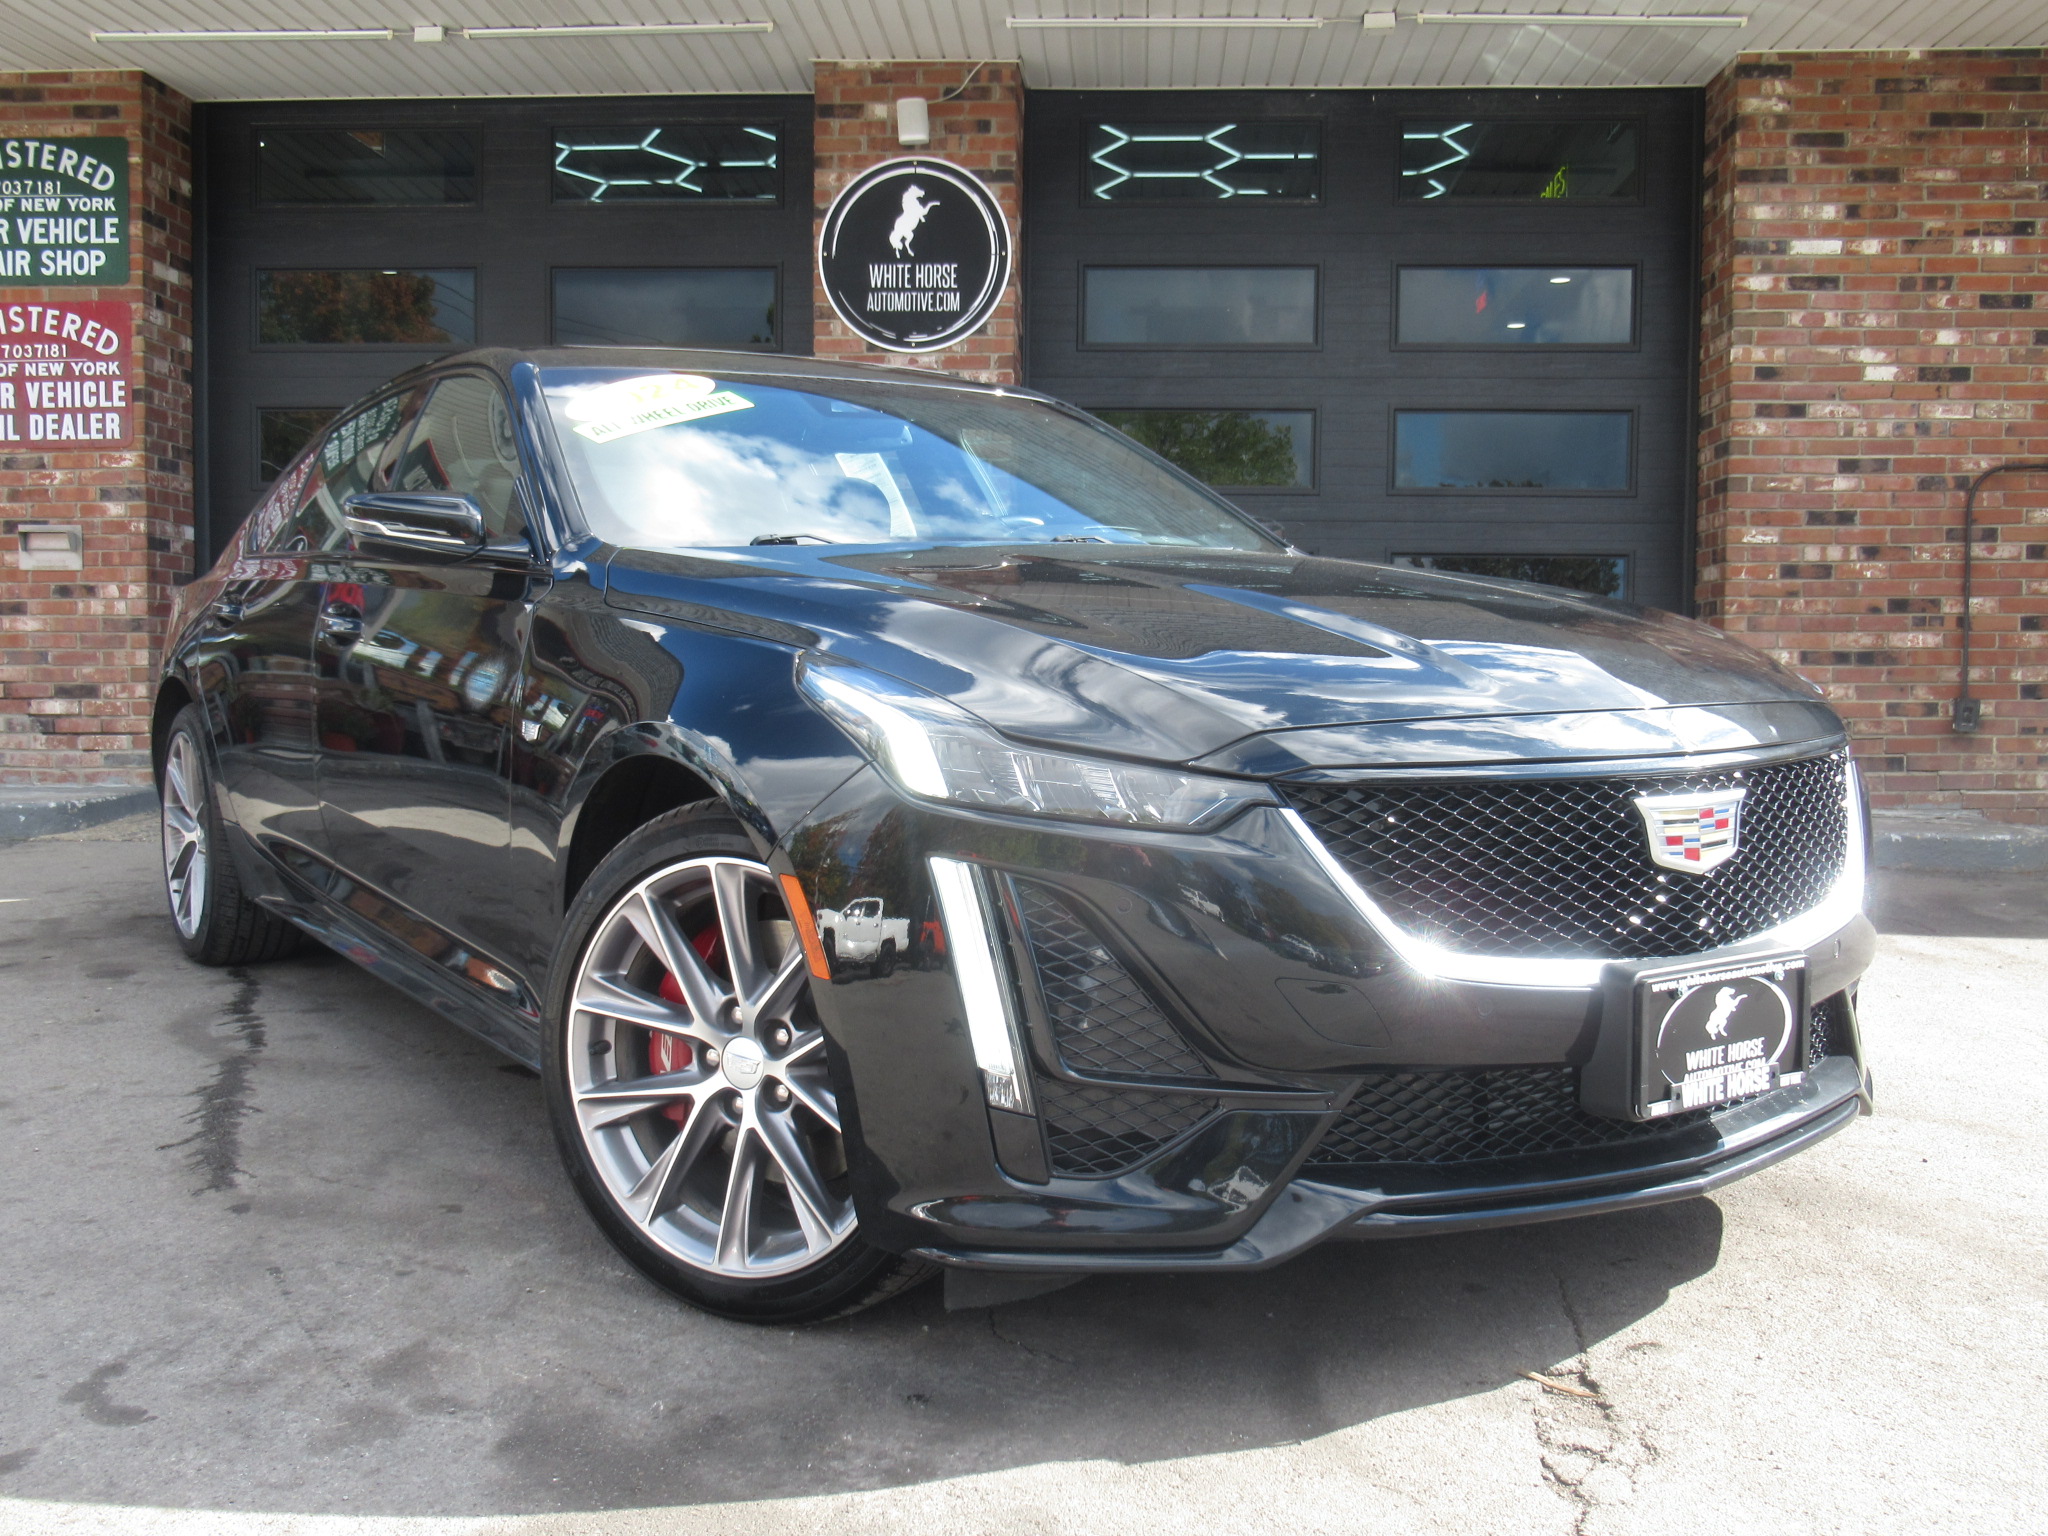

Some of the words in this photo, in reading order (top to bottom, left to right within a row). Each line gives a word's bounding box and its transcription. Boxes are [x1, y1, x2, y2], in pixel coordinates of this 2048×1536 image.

[0, 180, 61, 195] 037181
[21, 198, 60, 212] NEW
[67, 197, 116, 212] YORK
[17, 217, 119, 245] VEHICLE
[41, 250, 106, 276] SHOP
[869, 264, 911, 288] WHITE
[915, 264, 958, 288] HORSE
[867, 292, 960, 312] AUTOMOTIVE.COM
[1, 344, 67, 358] 7037181
[25, 362, 64, 376] NEW
[71, 361, 120, 375] YORK
[25, 381, 126, 409] VEHICLE
[687, 396, 737, 413] DRIVE
[30, 413, 121, 440] DEALER
[1652, 960, 1805, 993] www.whitehorseautomotive.com
[1686, 1045, 1726, 1071] WHITE
[1728, 1037, 1765, 1062] HORSE
[1682, 1075, 1725, 1108] WHITE
[1727, 1066, 1770, 1098] HORSE
